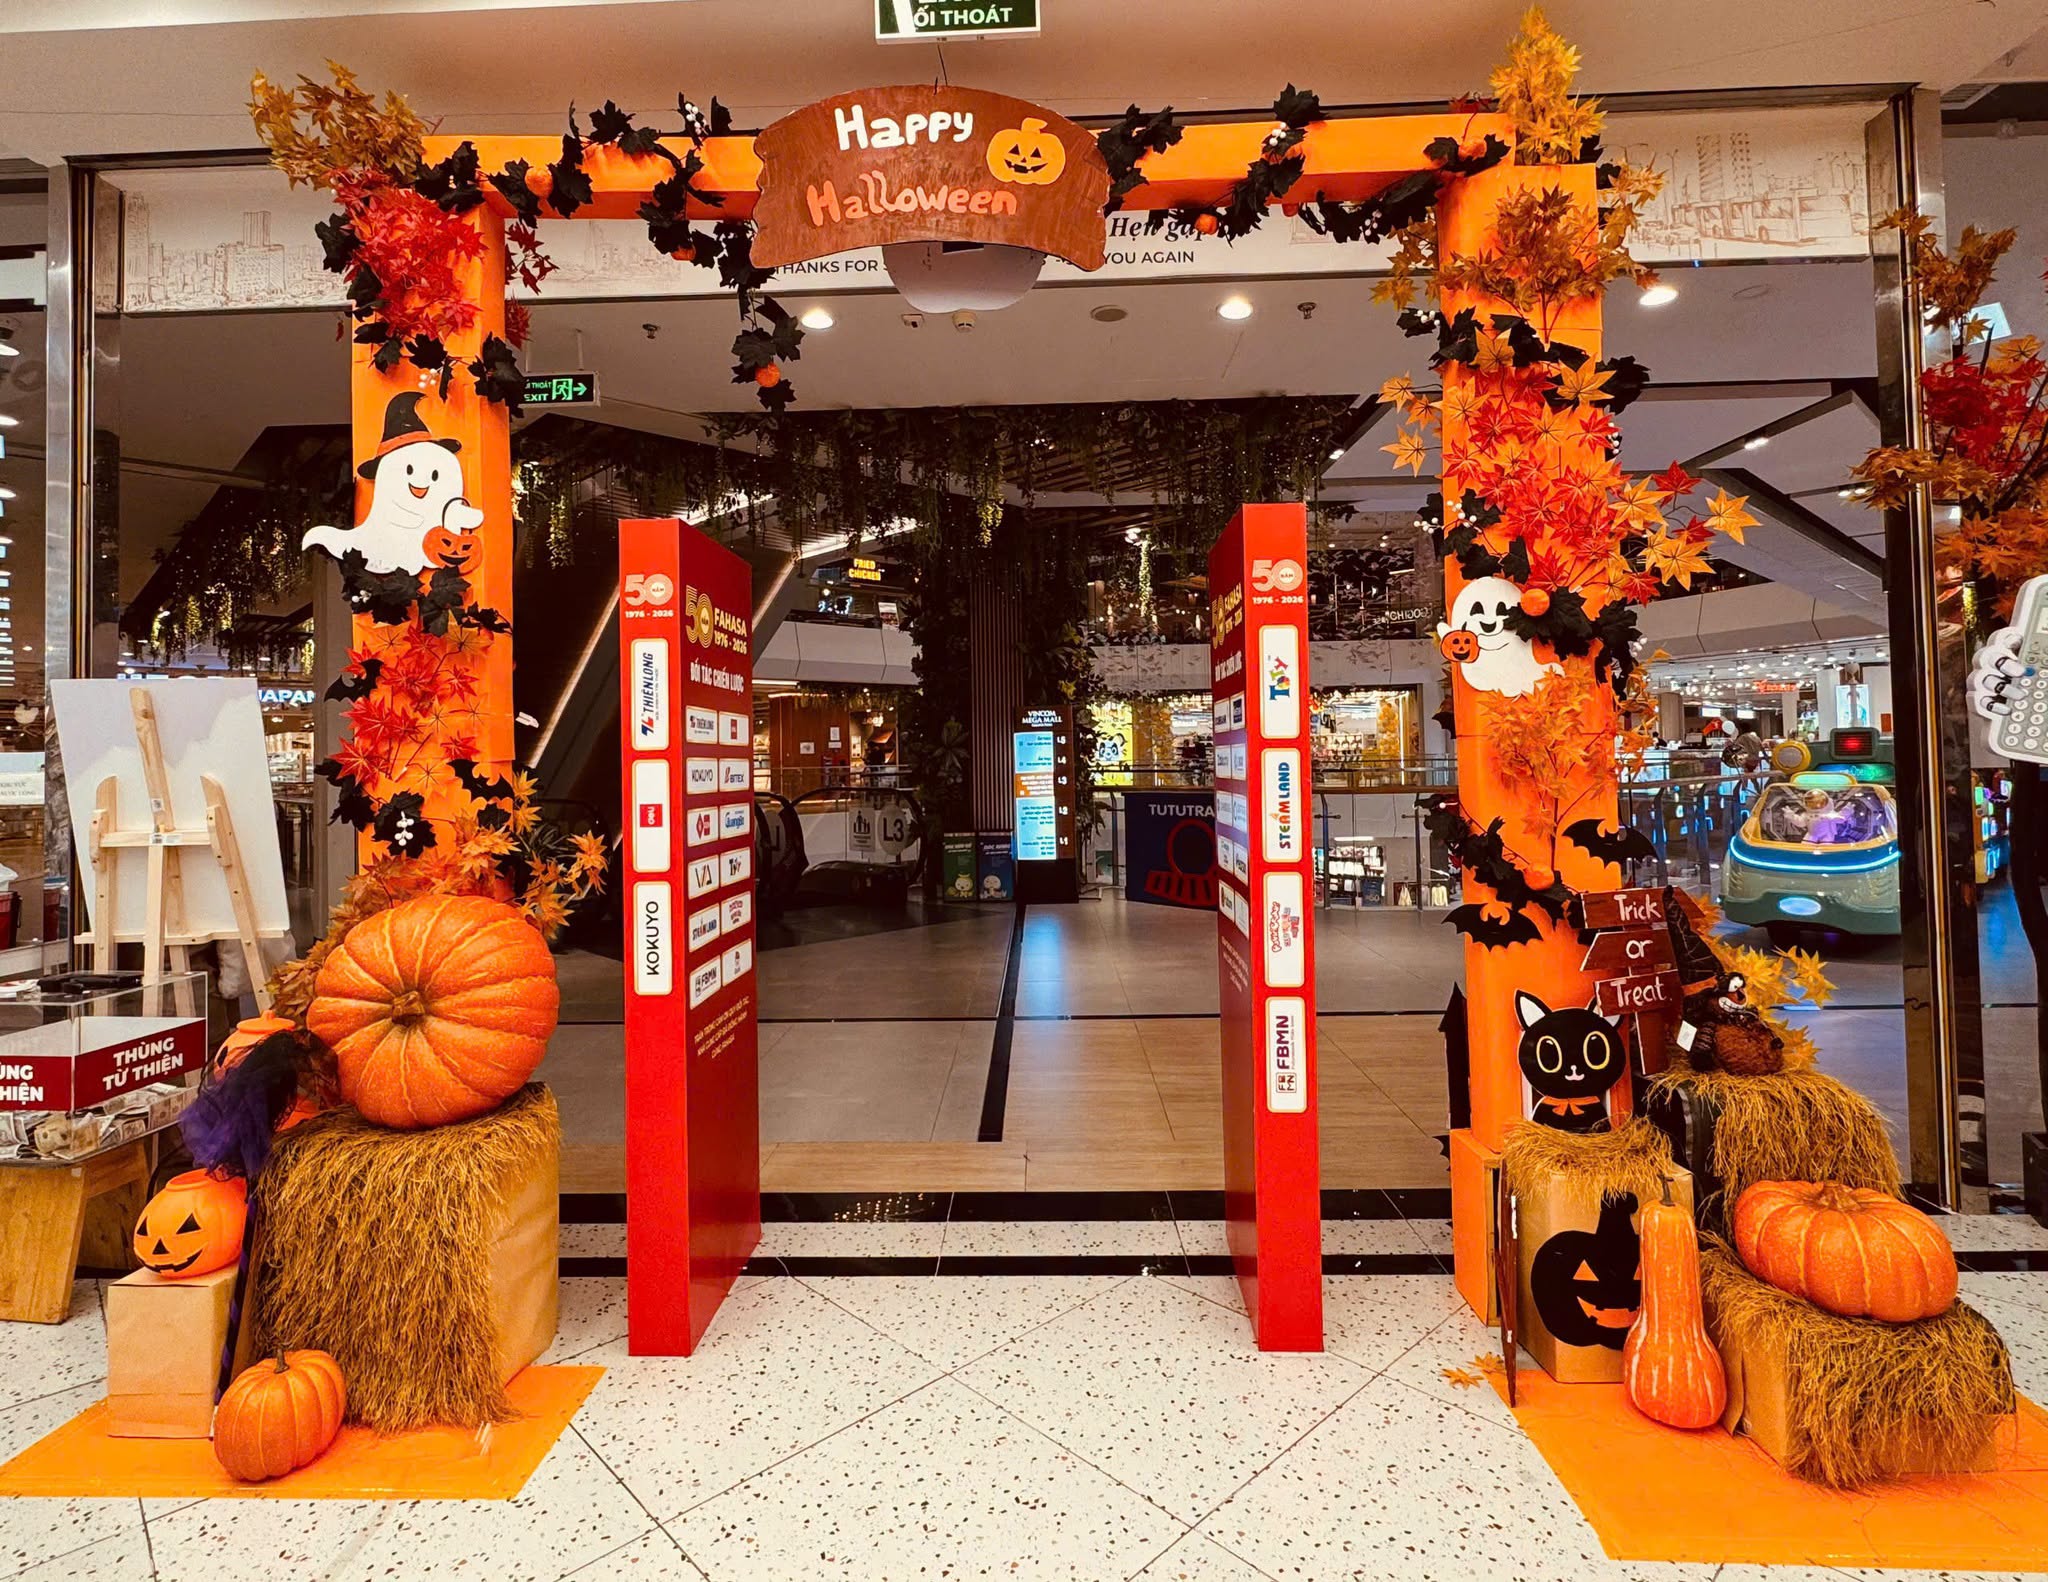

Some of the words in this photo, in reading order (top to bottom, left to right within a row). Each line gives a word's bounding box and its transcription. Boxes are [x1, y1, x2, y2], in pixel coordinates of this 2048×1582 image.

[940, 4, 1013, 26] THOÁT
[834, 104, 974, 151] Happy
[806, 170, 1017, 227] Halloween
[845, 260, 878, 272] FOR
[1141, 251, 1195, 264] AGAIN
[848, 568, 881, 581] CHICKEN
[1251, 558, 1304, 592] 50
[624, 573, 674, 607] 50
[1252, 596, 1274, 605] 1976
[1281, 595, 1304, 604] 2026
[624, 610, 645, 619] 1976
[652, 609, 674, 618] 2026
[714, 607, 748, 638] FAHASA
[883, 817, 904, 842] L3
[1613, 894, 1662, 921] Trick
[645, 901, 660, 976] KOKUYO
[1625, 940, 1653, 959] or
[113, 1036, 175, 1067] THÙNG
[1276, 1015, 1290, 1069] FBMN
[102, 1067, 129, 1091] TỪ
[132, 1053, 184, 1082] THIỆN
